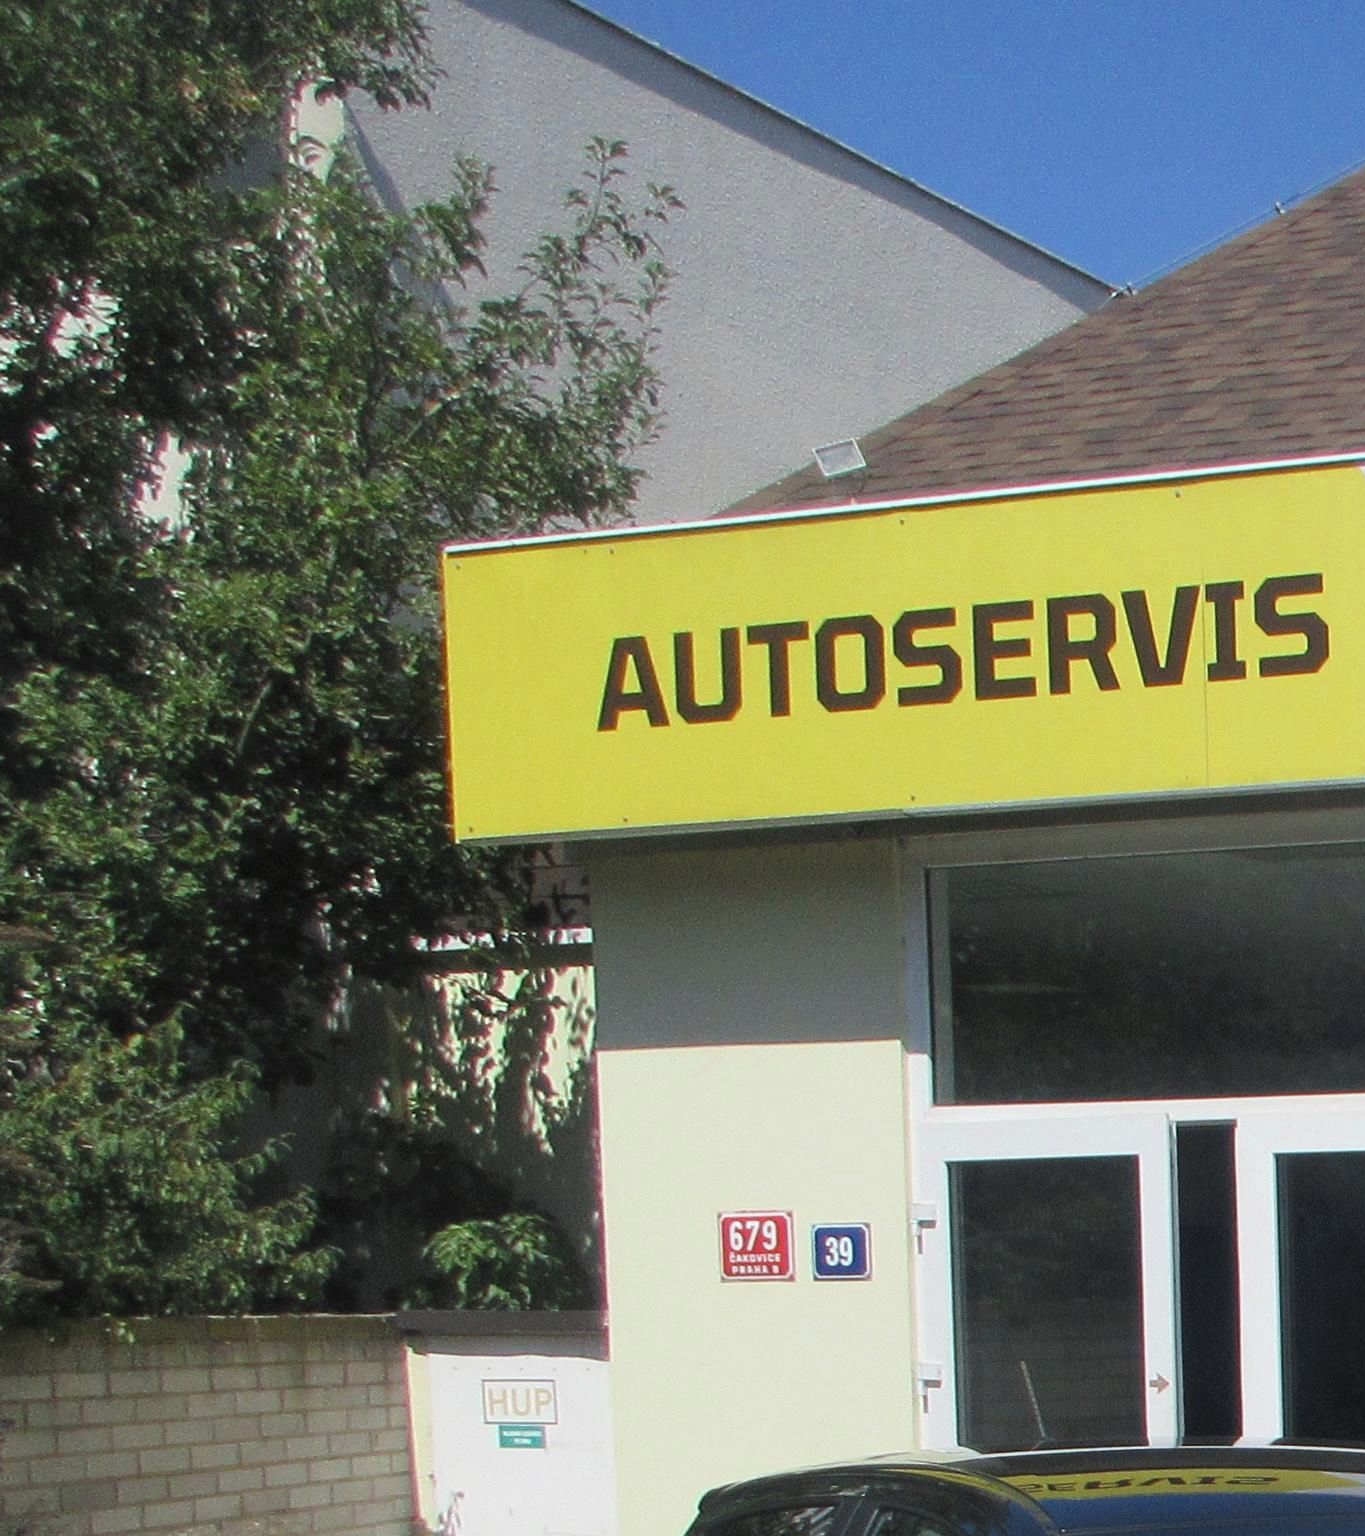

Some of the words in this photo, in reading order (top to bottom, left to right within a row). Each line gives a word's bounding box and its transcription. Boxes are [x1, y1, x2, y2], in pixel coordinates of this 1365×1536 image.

[596, 572, 1331, 733] AUTOSERVIS
[729, 1220, 777, 1251] 679
[825, 1236, 854, 1267] 39
[487, 1387, 552, 1416] HUP
